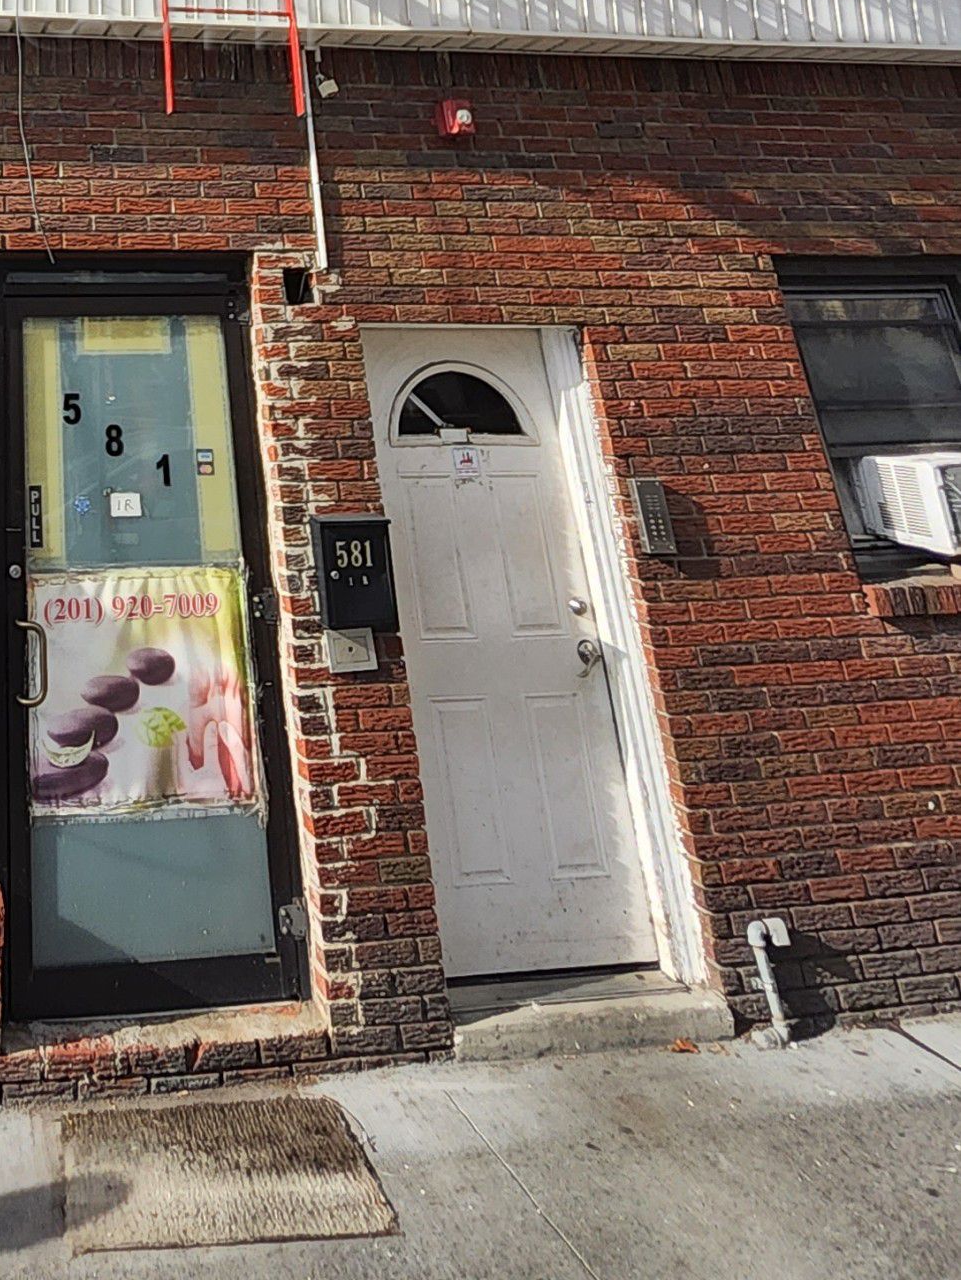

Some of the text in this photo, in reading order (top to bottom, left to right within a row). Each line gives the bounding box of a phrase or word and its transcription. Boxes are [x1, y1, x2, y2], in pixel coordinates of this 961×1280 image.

[31, 490, 41, 543] PULL
[335, 540, 374, 568] 581
[43, 591, 220, 629] (201) 920-7009
